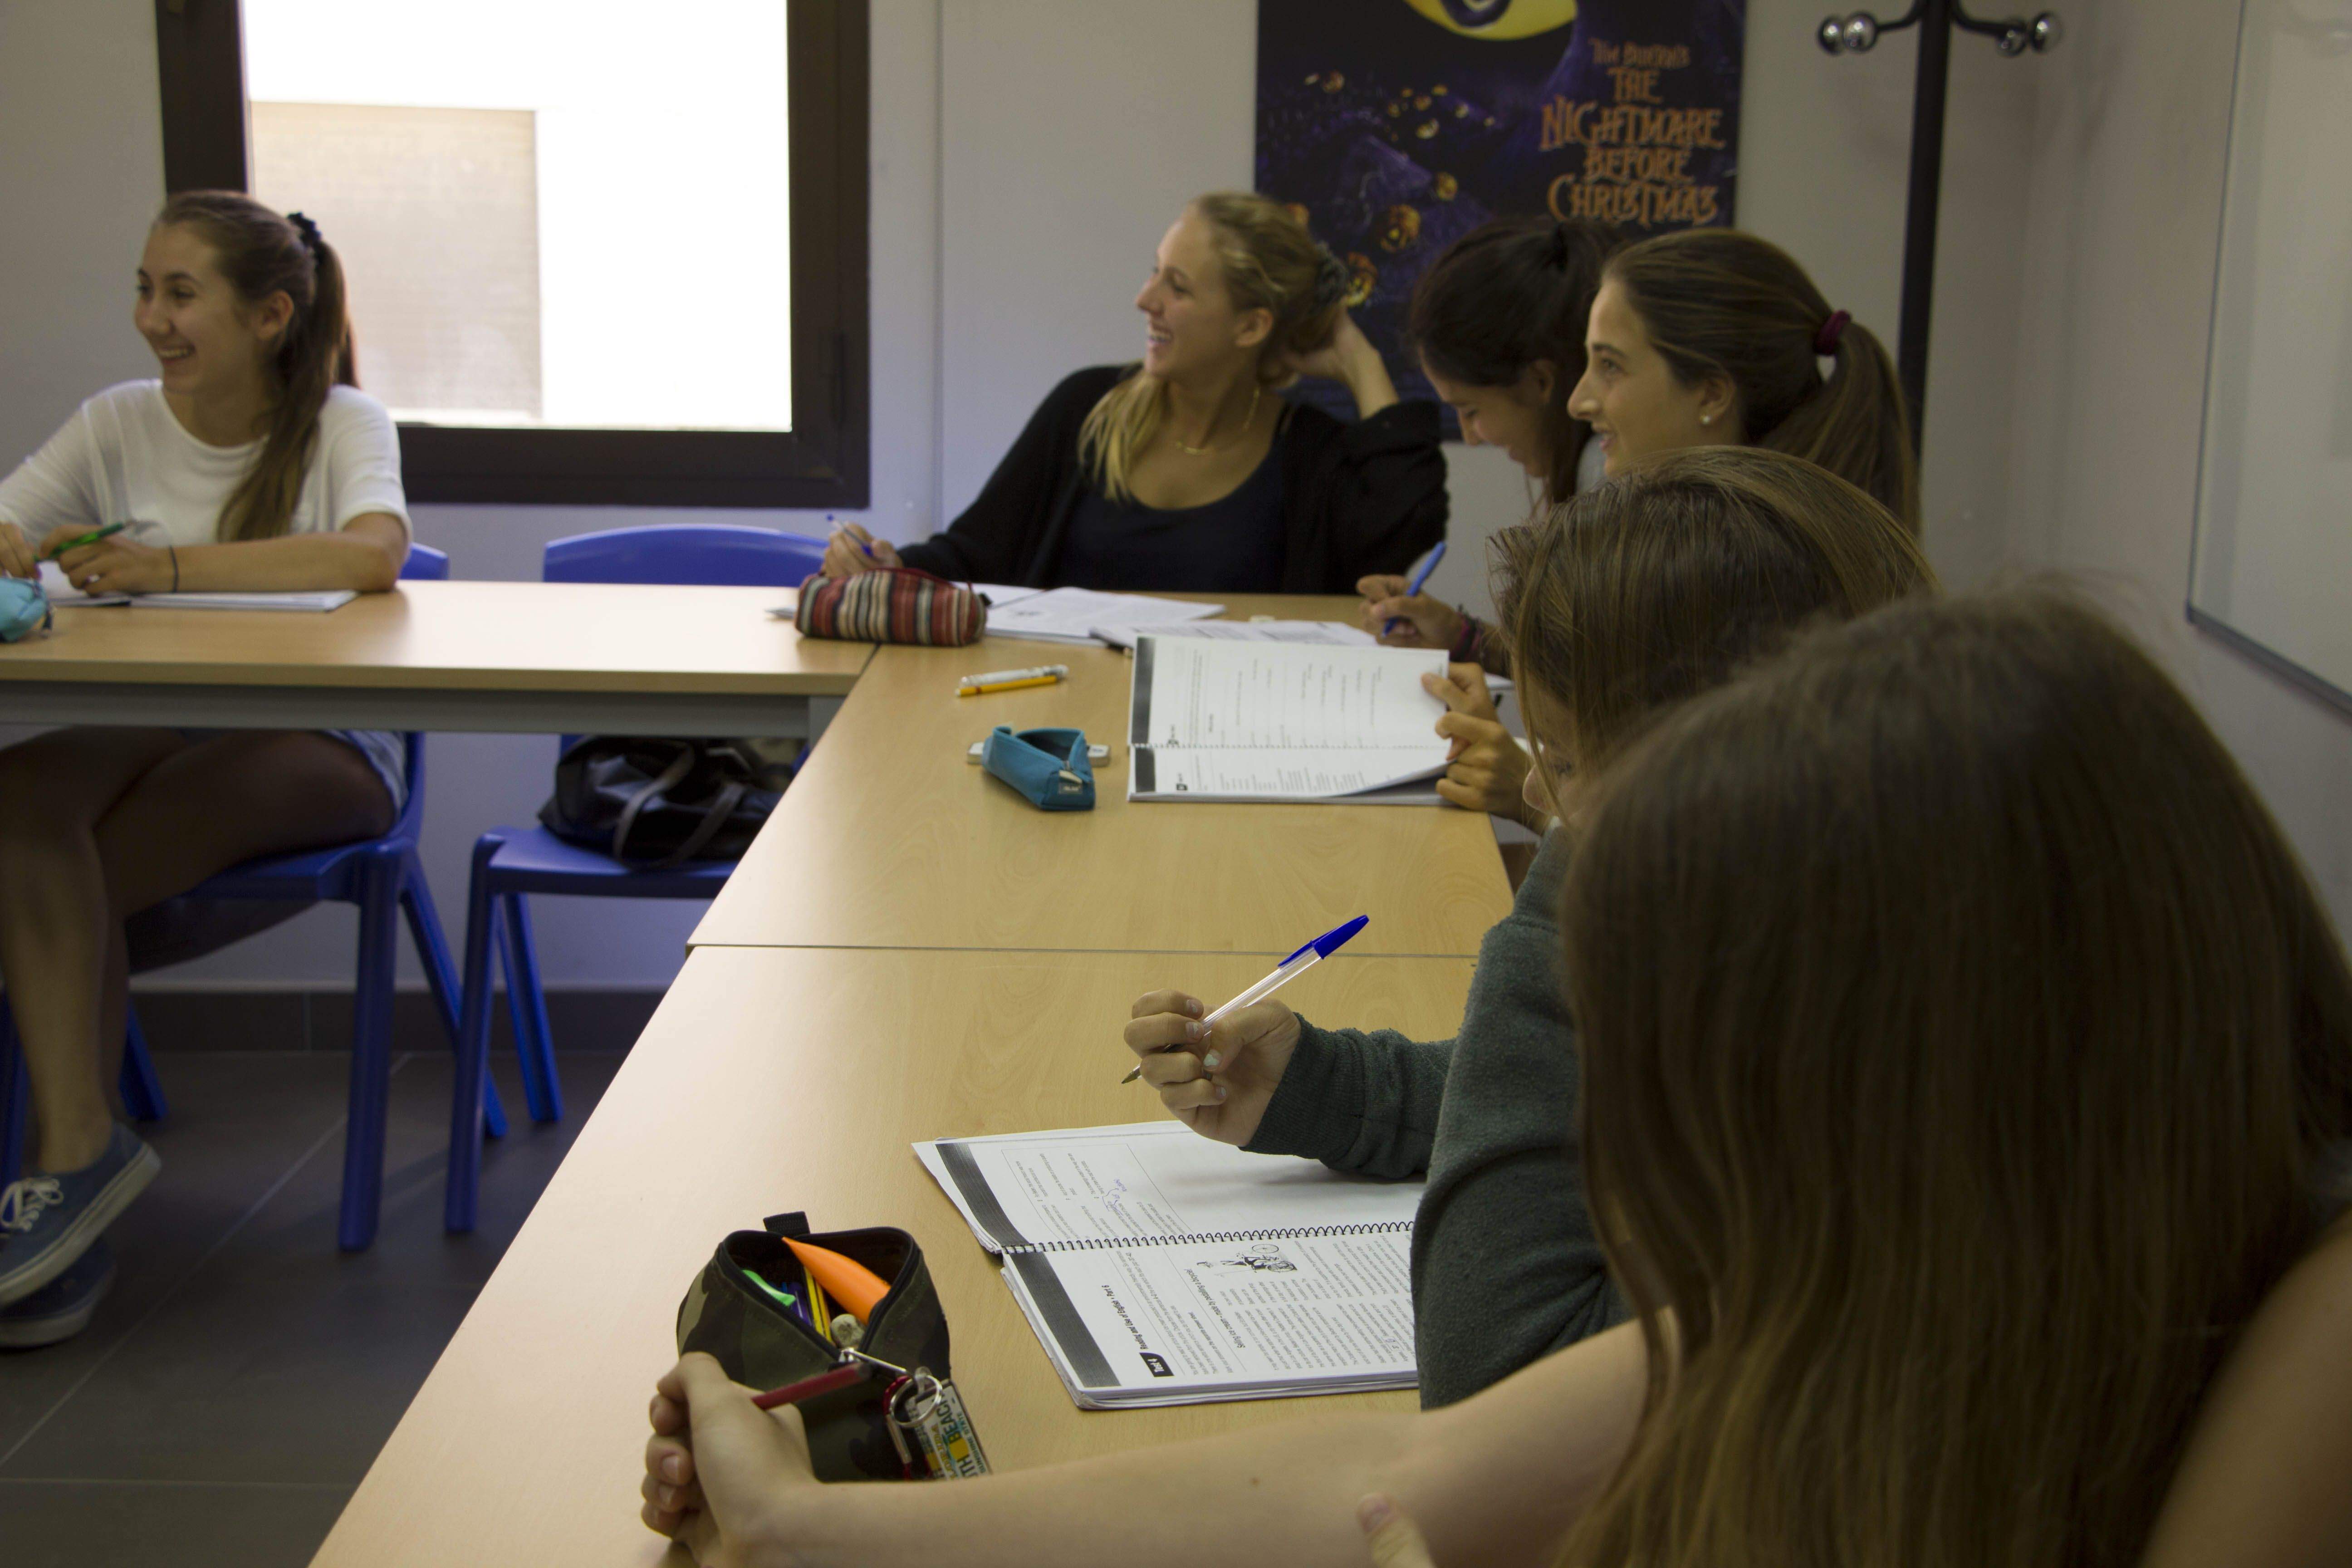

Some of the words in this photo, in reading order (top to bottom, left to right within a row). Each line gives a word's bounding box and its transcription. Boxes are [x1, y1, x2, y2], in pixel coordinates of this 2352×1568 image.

[1606, 67, 1664, 104] THE
[1540, 95, 1725, 151] NIGHTMARE
[1583, 146, 1696, 184] BEFORE
[1548, 174, 1718, 229] CHRISTMAS
[1104, 1288, 1114, 1296] Part
[1197, 1285, 1212, 1300] pedalling
[1112, 1300, 1125, 1313] English
[1211, 1306, 1221, 1315] made
[1220, 1318, 1232, 1329] cream
[1134, 1334, 1147, 1349] Reading
[1233, 1336, 1245, 1348] Selling
[1151, 1362, 1164, 1372] Test
